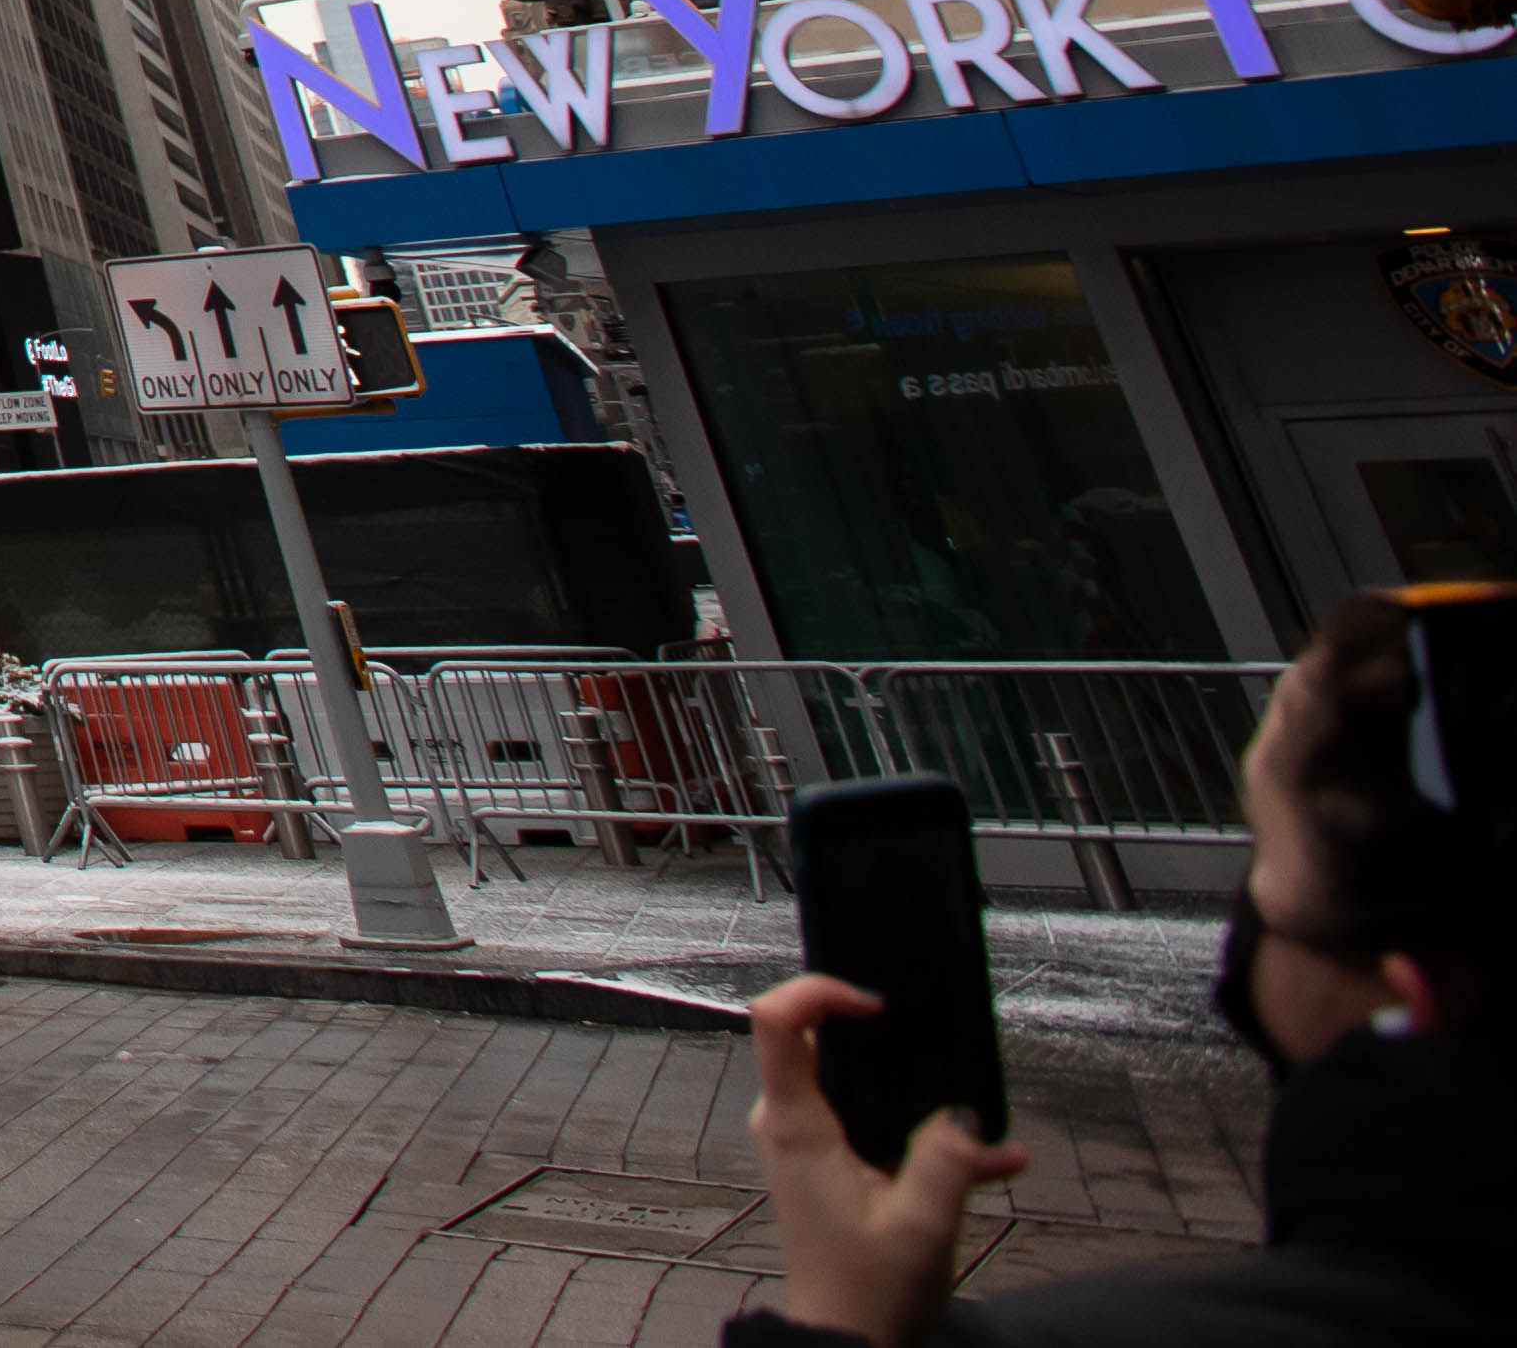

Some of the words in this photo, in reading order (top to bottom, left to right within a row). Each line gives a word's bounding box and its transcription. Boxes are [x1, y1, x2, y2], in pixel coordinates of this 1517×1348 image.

[249, 0, 612, 183] NEW
[142, 373, 197, 399] ONLY
[208, 370, 266, 397] ONLY
[277, 367, 338, 394] ONLY
[22, 396, 47, 408] ZONE
[15, 411, 50, 424] MOVING
